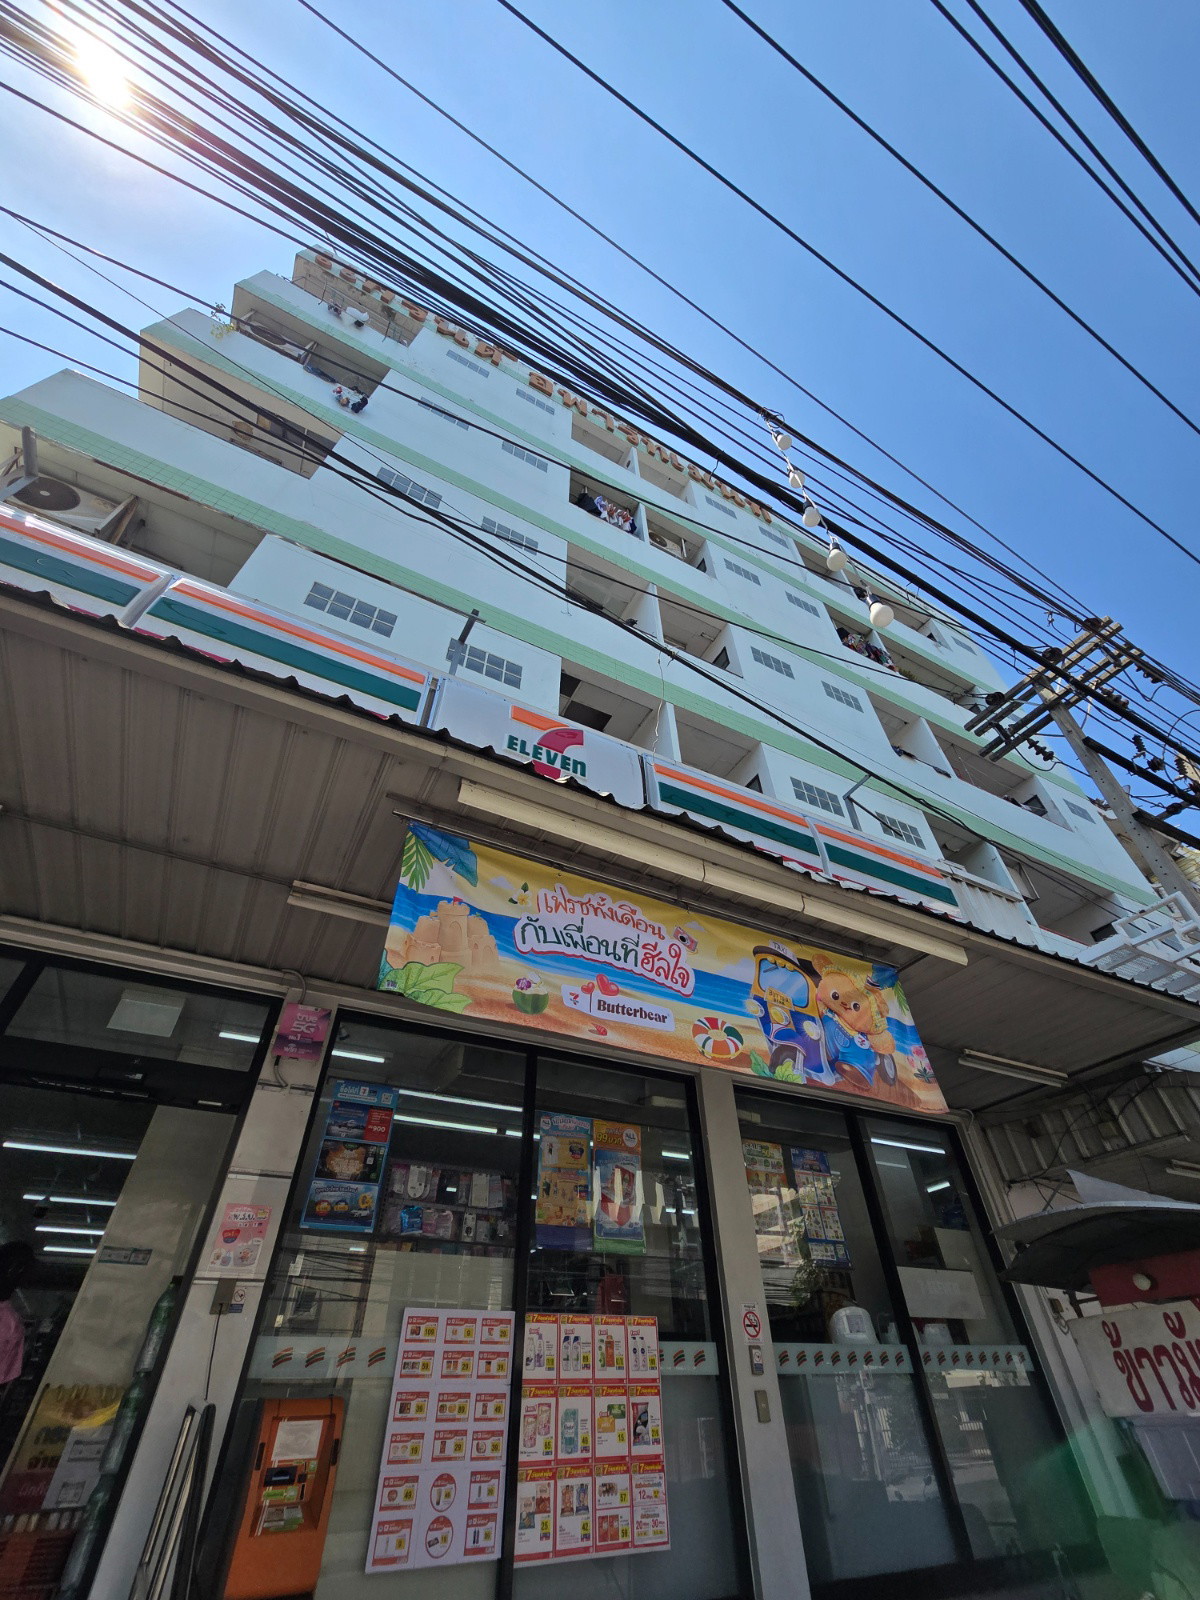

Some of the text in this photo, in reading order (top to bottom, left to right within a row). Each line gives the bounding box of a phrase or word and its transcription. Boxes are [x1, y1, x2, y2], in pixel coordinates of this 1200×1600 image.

[297, 1013, 318, 1023] true
[597, 999, 668, 1024] Butterbear
[1102, 1311, 1200, 1412] ข้าวมั
